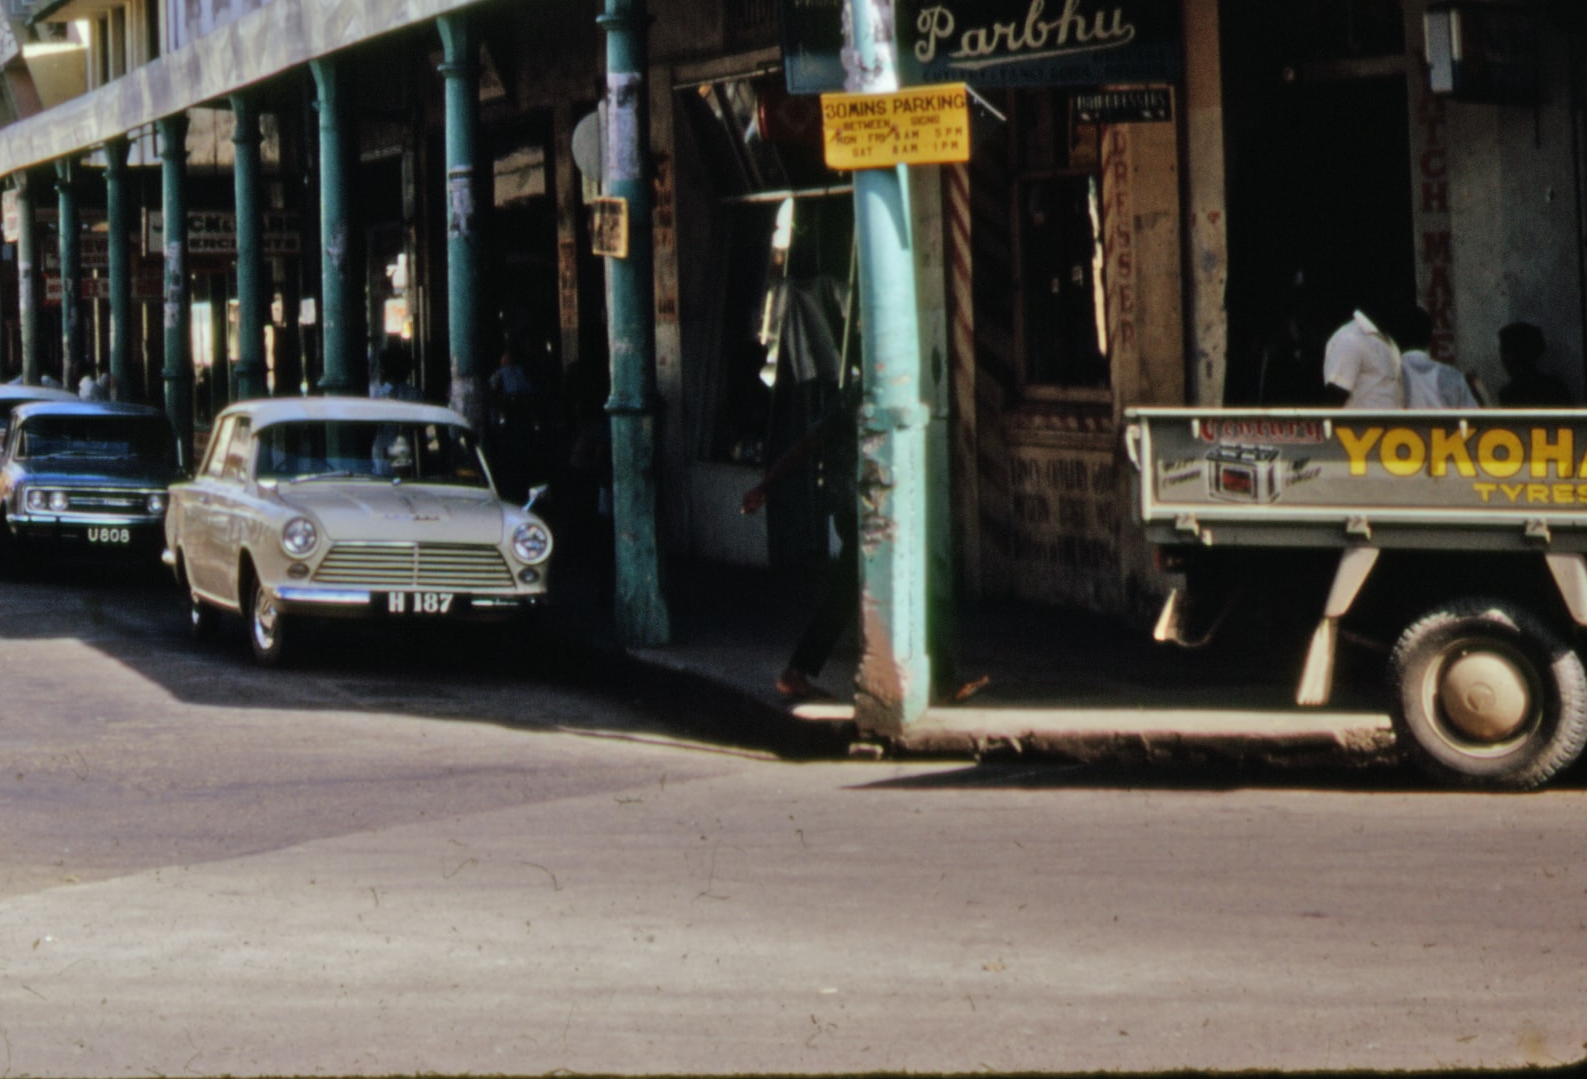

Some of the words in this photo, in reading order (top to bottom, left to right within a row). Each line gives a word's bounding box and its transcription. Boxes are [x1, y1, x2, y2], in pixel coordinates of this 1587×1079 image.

[893, 94, 965, 114] PARKING
[1334, 427, 1587, 478] YOKOH
[87, 527, 131, 544] U808
[388, 591, 406, 613] H
[411, 591, 455, 614] 187
